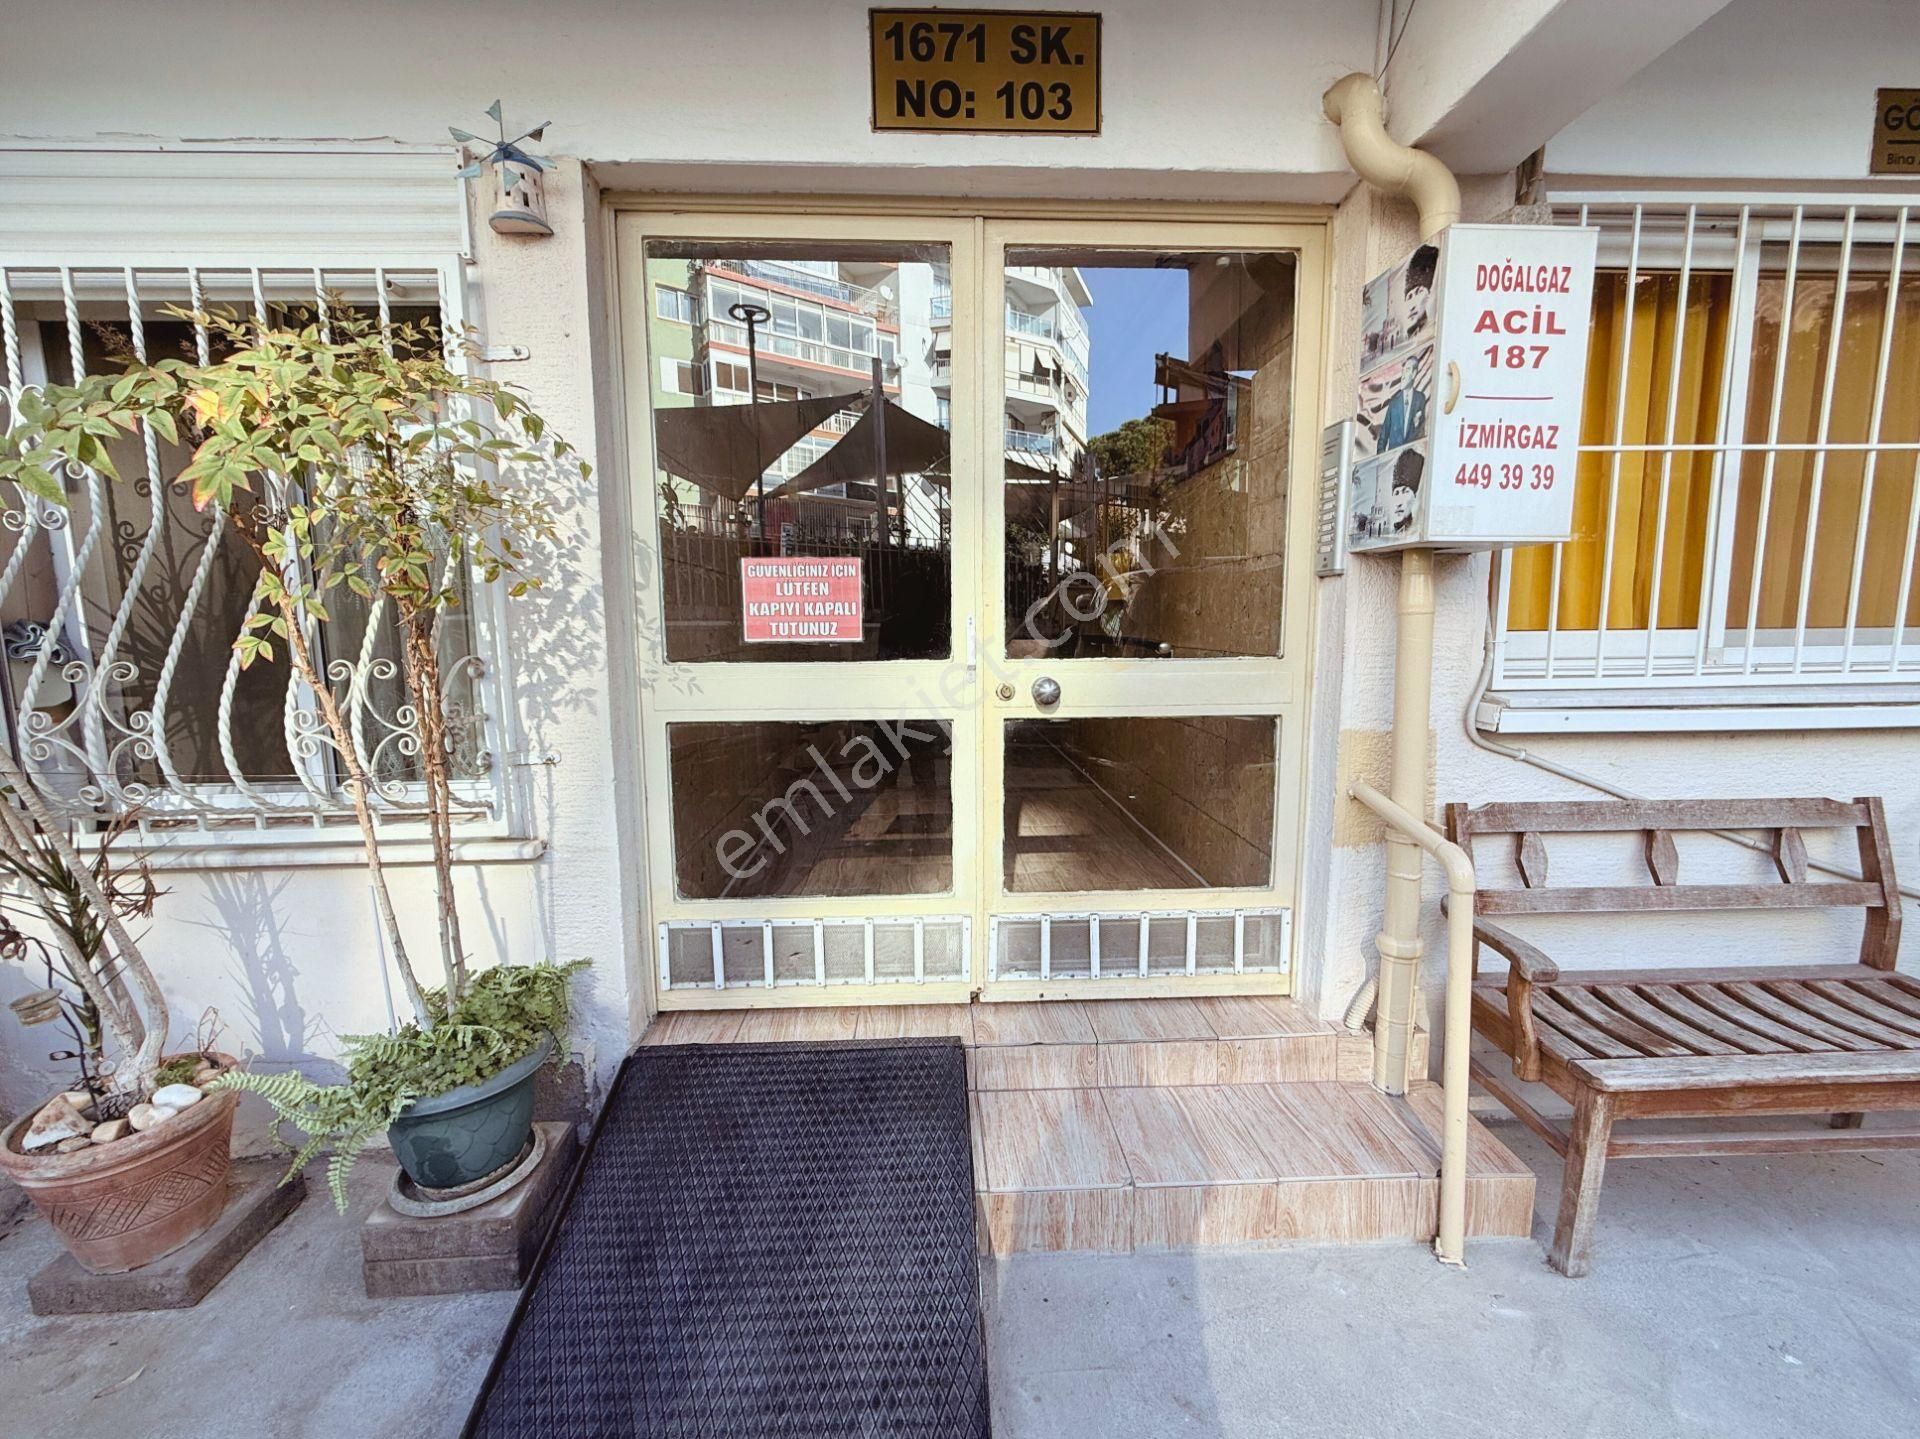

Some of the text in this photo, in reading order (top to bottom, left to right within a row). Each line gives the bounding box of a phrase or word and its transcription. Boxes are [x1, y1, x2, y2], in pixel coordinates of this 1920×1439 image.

[884, 22, 1084, 65] 1671 SK.
[896, 79, 1073, 120] NO: 103
[1887, 153, 1916, 165] Bina
[1476, 257, 1572, 293] DOĞALGAZ
[1473, 305, 1567, 335] ACİL
[1484, 345, 1549, 369] 187
[1458, 417, 1559, 449] İZMİRGAZ
[1455, 463, 1555, 490] 449 39 39
[775, 579, 830, 596] LÜTFEN
[749, 602, 857, 616] KAPIYI KAPALI
[769, 622, 838, 636] TUTUNUZ
